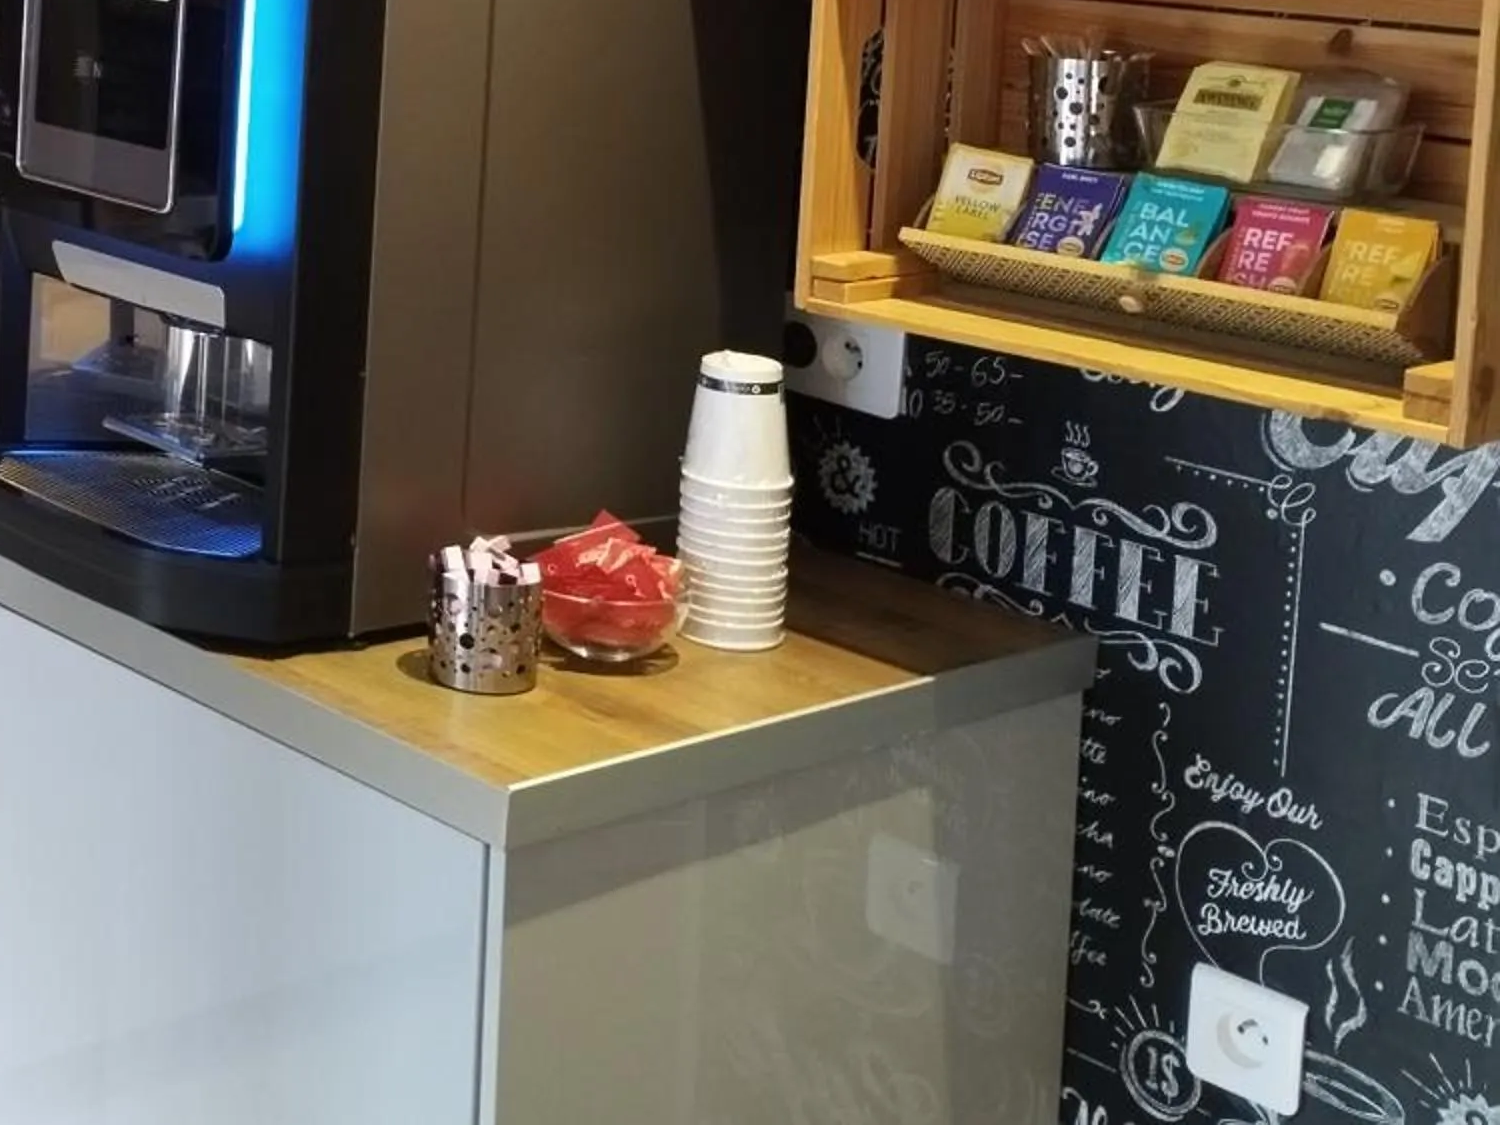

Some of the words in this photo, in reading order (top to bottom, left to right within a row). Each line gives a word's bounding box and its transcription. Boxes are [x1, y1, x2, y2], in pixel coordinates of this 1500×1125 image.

[1139, 202, 1189, 228] BAL
[1129, 223, 1171, 244] AN
[1243, 227, 1294, 251] REF
[1123, 241, 1161, 264] CE
[1237, 250, 1271, 273] RE
[1351, 241, 1398, 265] REF
[858, 521, 901, 553] HOT
[928, 486, 1225, 647] COFFEE
[1367, 685, 1491, 758] All
[1184, 754, 1265, 814] Enjoy
[1267, 787, 1323, 830] Our
[1207, 868, 1314, 913] Freshly
[1199, 902, 1308, 941] Brewed
